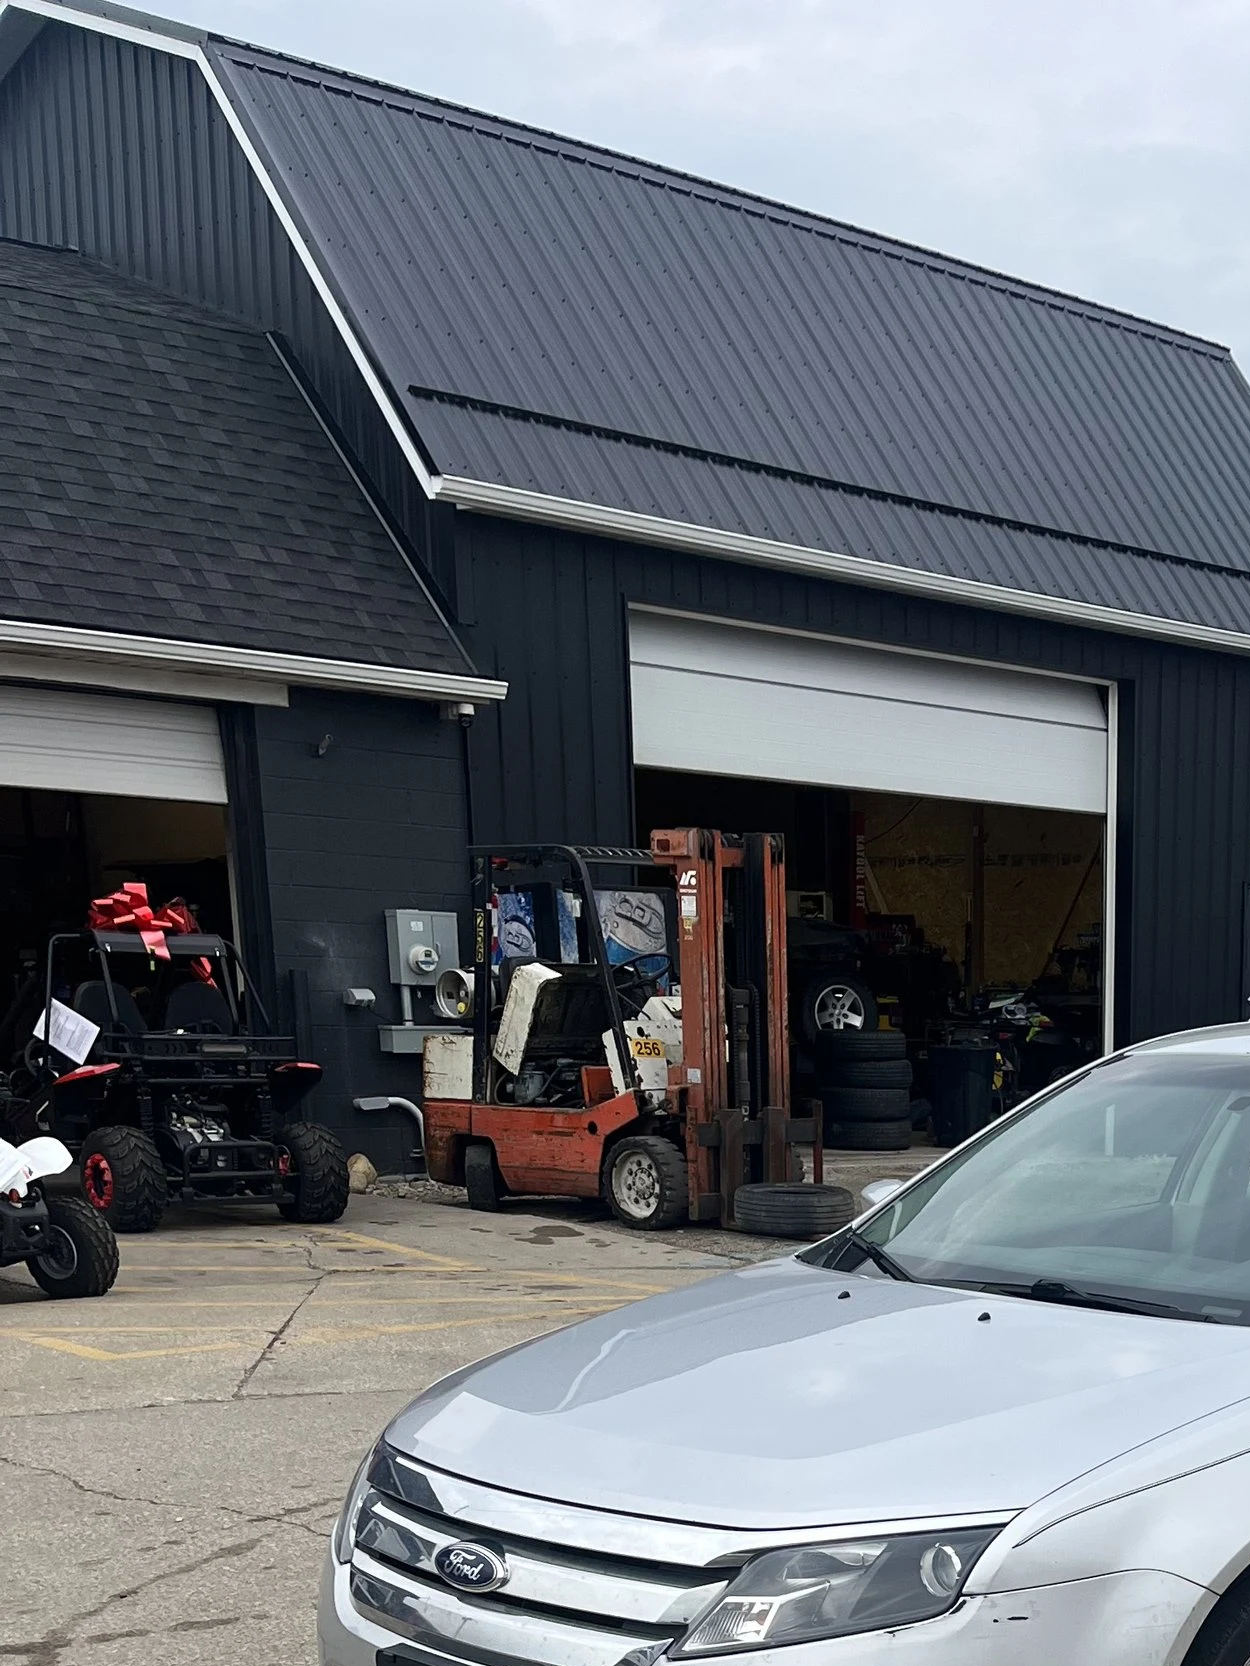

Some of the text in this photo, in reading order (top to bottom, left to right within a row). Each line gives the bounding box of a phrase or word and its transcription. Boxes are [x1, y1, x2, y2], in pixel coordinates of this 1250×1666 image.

[856, 884, 865, 909] LIFT
[476, 912, 485, 962] 256
[635, 1041, 661, 1056] 256
[444, 1549, 484, 1580] Ford
